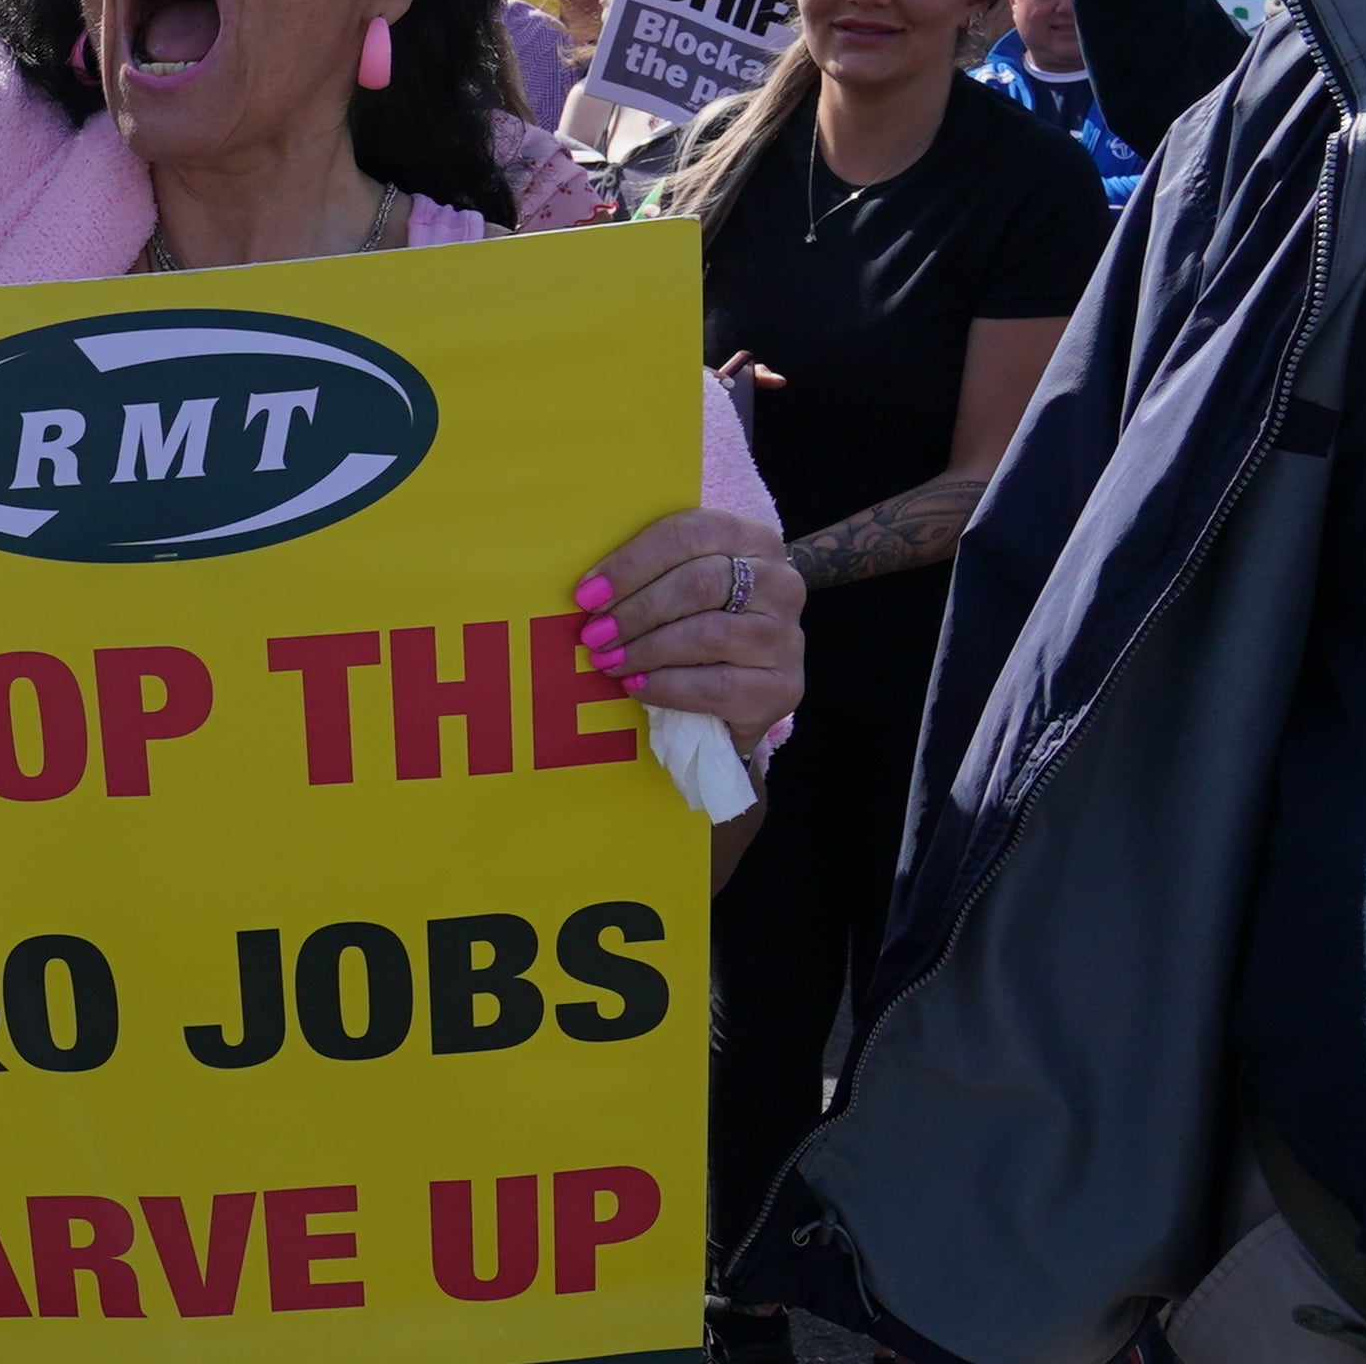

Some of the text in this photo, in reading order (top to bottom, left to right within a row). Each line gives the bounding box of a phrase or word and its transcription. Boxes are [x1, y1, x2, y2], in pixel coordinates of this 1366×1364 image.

[625, 43, 688, 88] the
[633, 9, 766, 84] Blocka
[8, 386, 320, 491] RMT
[266, 611, 638, 787] THE
[183, 901, 672, 1070] JOBS
[429, 1165, 663, 1303] UP
